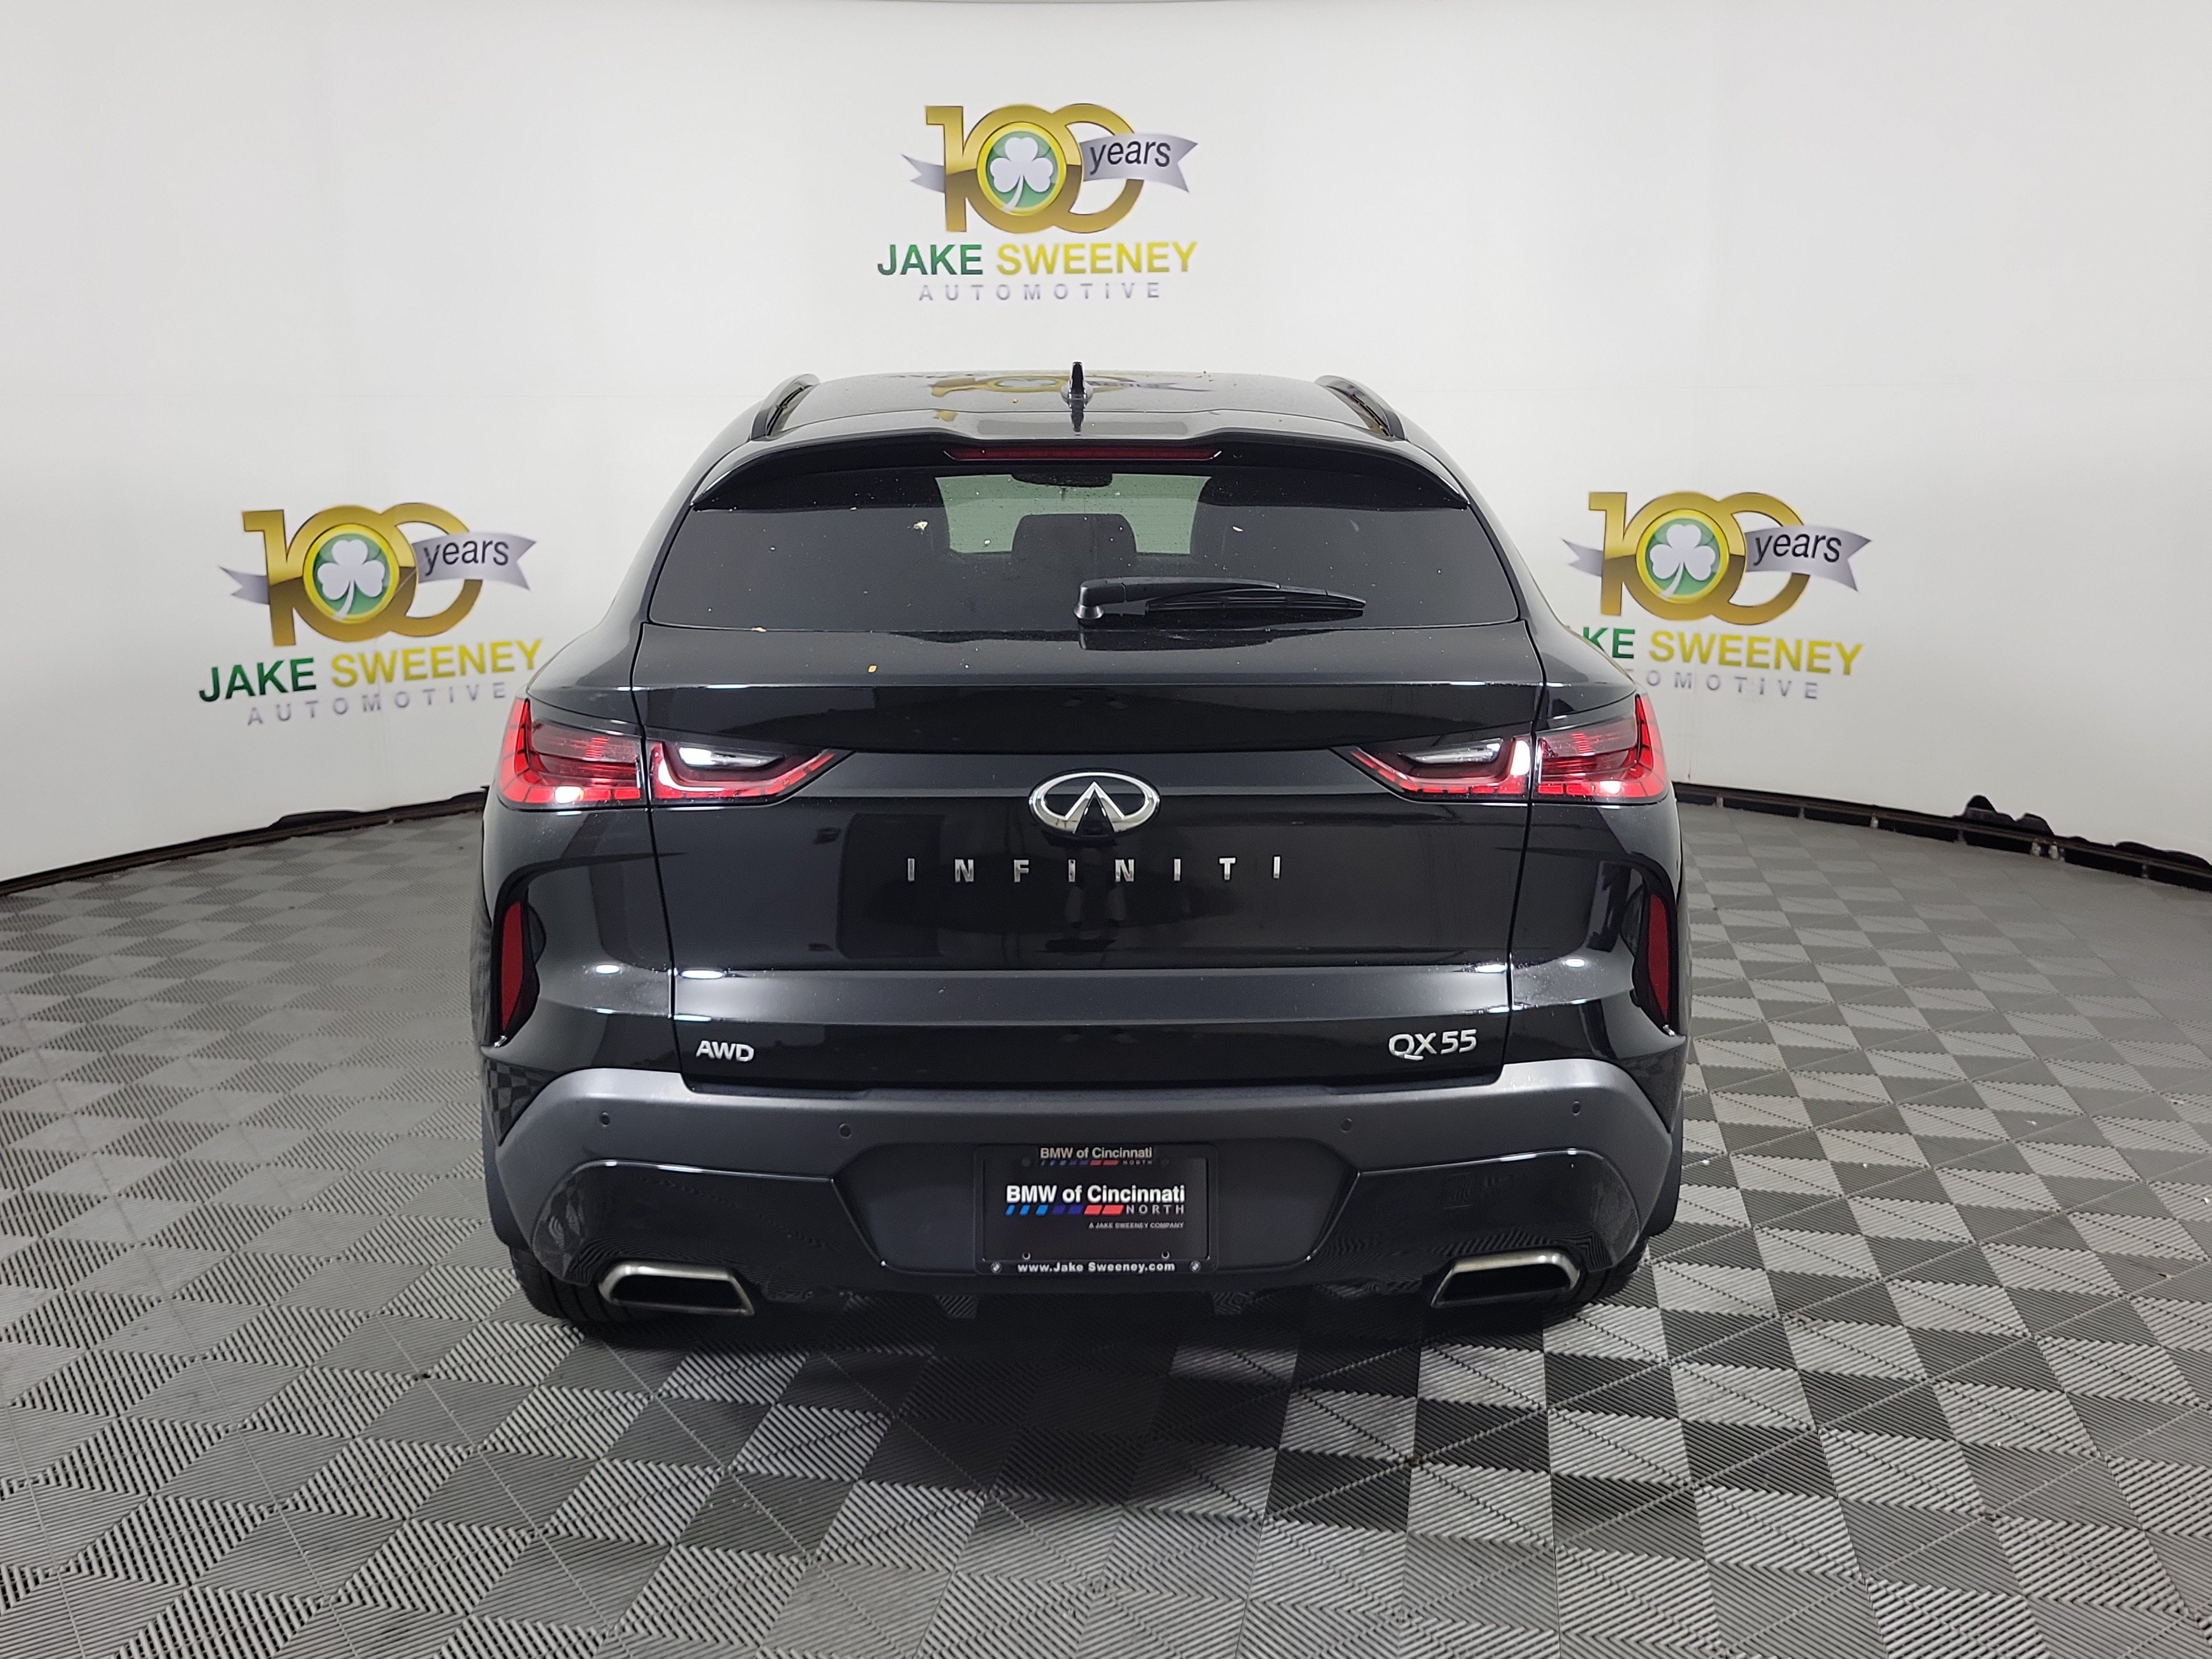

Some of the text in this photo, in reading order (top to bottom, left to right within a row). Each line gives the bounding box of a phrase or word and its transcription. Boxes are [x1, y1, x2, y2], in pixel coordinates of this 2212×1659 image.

[1090, 140, 1171, 175] years
[877, 241, 1198, 275] JAKE SWEENEY
[919, 283, 1160, 301] AUTOMOTIVE
[423, 539, 509, 575] years
[1754, 533, 1842, 566] years
[1583, 627, 1864, 676] KE SWEENEY
[199, 639, 544, 703] JAKE SWEENEY
[1626, 668, 1818, 699] OMOTIVE
[247, 682, 507, 726] AUTOMOTIVE
[907, 855, 1280, 883] INFINITI
[696, 1040, 754, 1062] AWD
[1040, 1147, 1152, 1159] BMW of Cincinnati
[1006, 1184, 1186, 1203] BMW of Cincinnati
[1126, 1205, 1184, 1215] NORTH
[1017, 1262, 1176, 1273] www.Jake Sweeney.com
